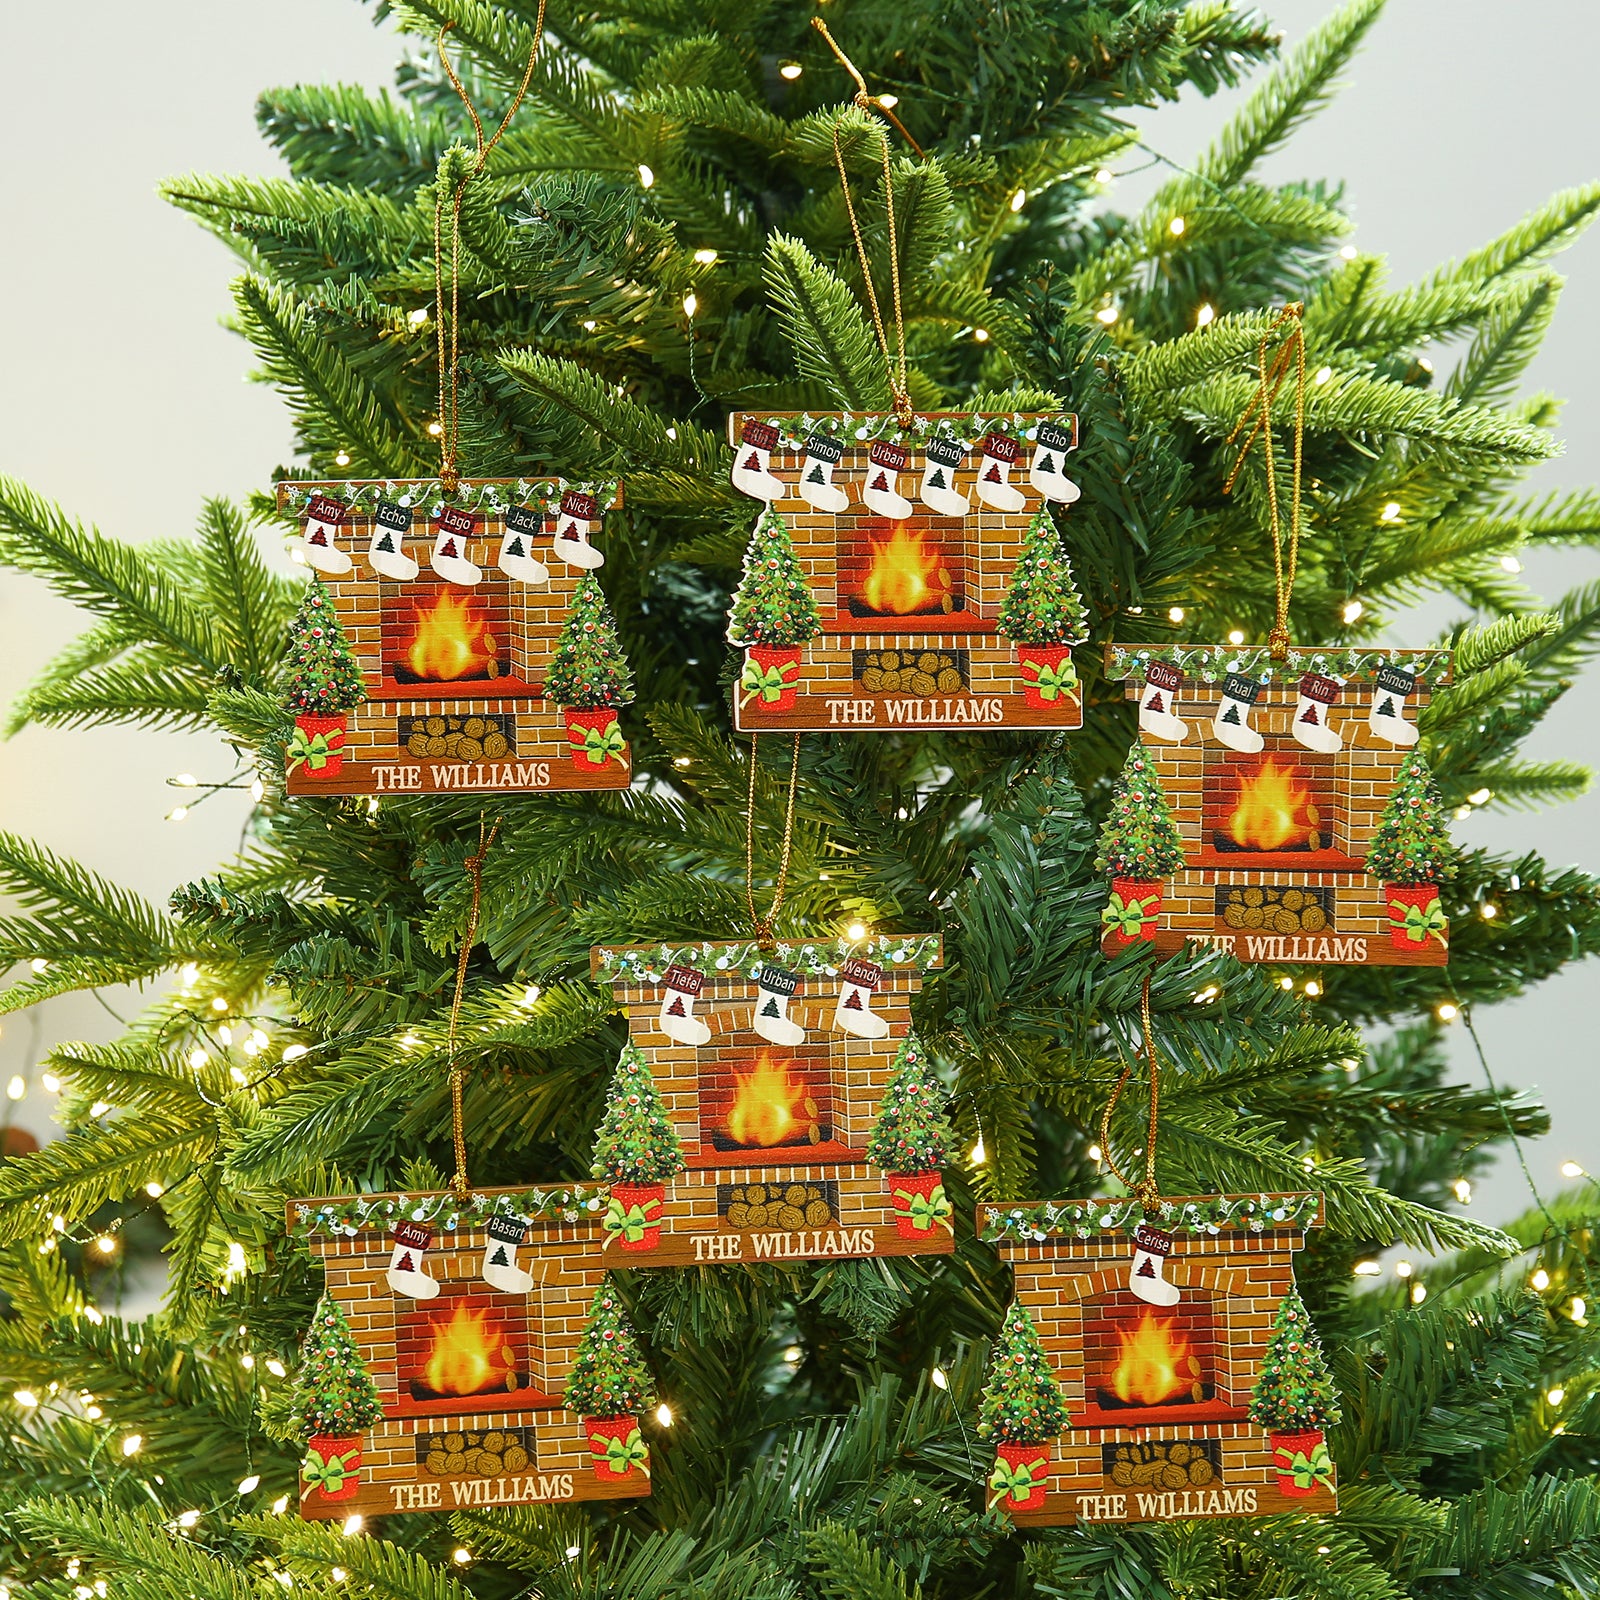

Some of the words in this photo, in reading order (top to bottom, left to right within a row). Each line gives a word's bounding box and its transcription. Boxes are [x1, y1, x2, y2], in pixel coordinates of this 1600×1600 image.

[807, 436, 841, 460] Simon
[991, 437, 1015, 458] Yoki
[1040, 428, 1067, 447] Echo
[871, 444, 905, 467] Urban
[928, 438, 966, 465] Wendy
[315, 501, 341, 521] Amy
[380, 506, 406, 525] Echo
[566, 497, 590, 516] Nick
[444, 510, 471, 530] Lago
[512, 512, 536, 530] Jack
[1150, 666, 1178, 686] Olive
[1380, 668, 1413, 692] Simon
[1228, 679, 1253, 698] Pual
[1311, 680, 1329, 697] Rin
[825, 699, 876, 724] THE
[883, 698, 1004, 723] WILLIAMS
[371, 765, 423, 790] THE
[429, 763, 551, 789] WILLIAMS
[1244, 935, 1368, 962] WILLIAMS
[670, 970, 701, 991] Tiefel
[762, 969, 796, 992] Urban
[843, 960, 881, 986] Wendy
[401, 1225, 428, 1245] Amy
[491, 1217, 526, 1240] Basart
[689, 1234, 743, 1261] THE
[750, 1229, 875, 1259] WILLIAMS
[1137, 1230, 1170, 1252] Cerise
[389, 1482, 442, 1510] THE
[449, 1474, 574, 1506] WILLIAMS
[1076, 1494, 1128, 1520] THE
[1135, 1488, 1258, 1519] WILLIAMS
